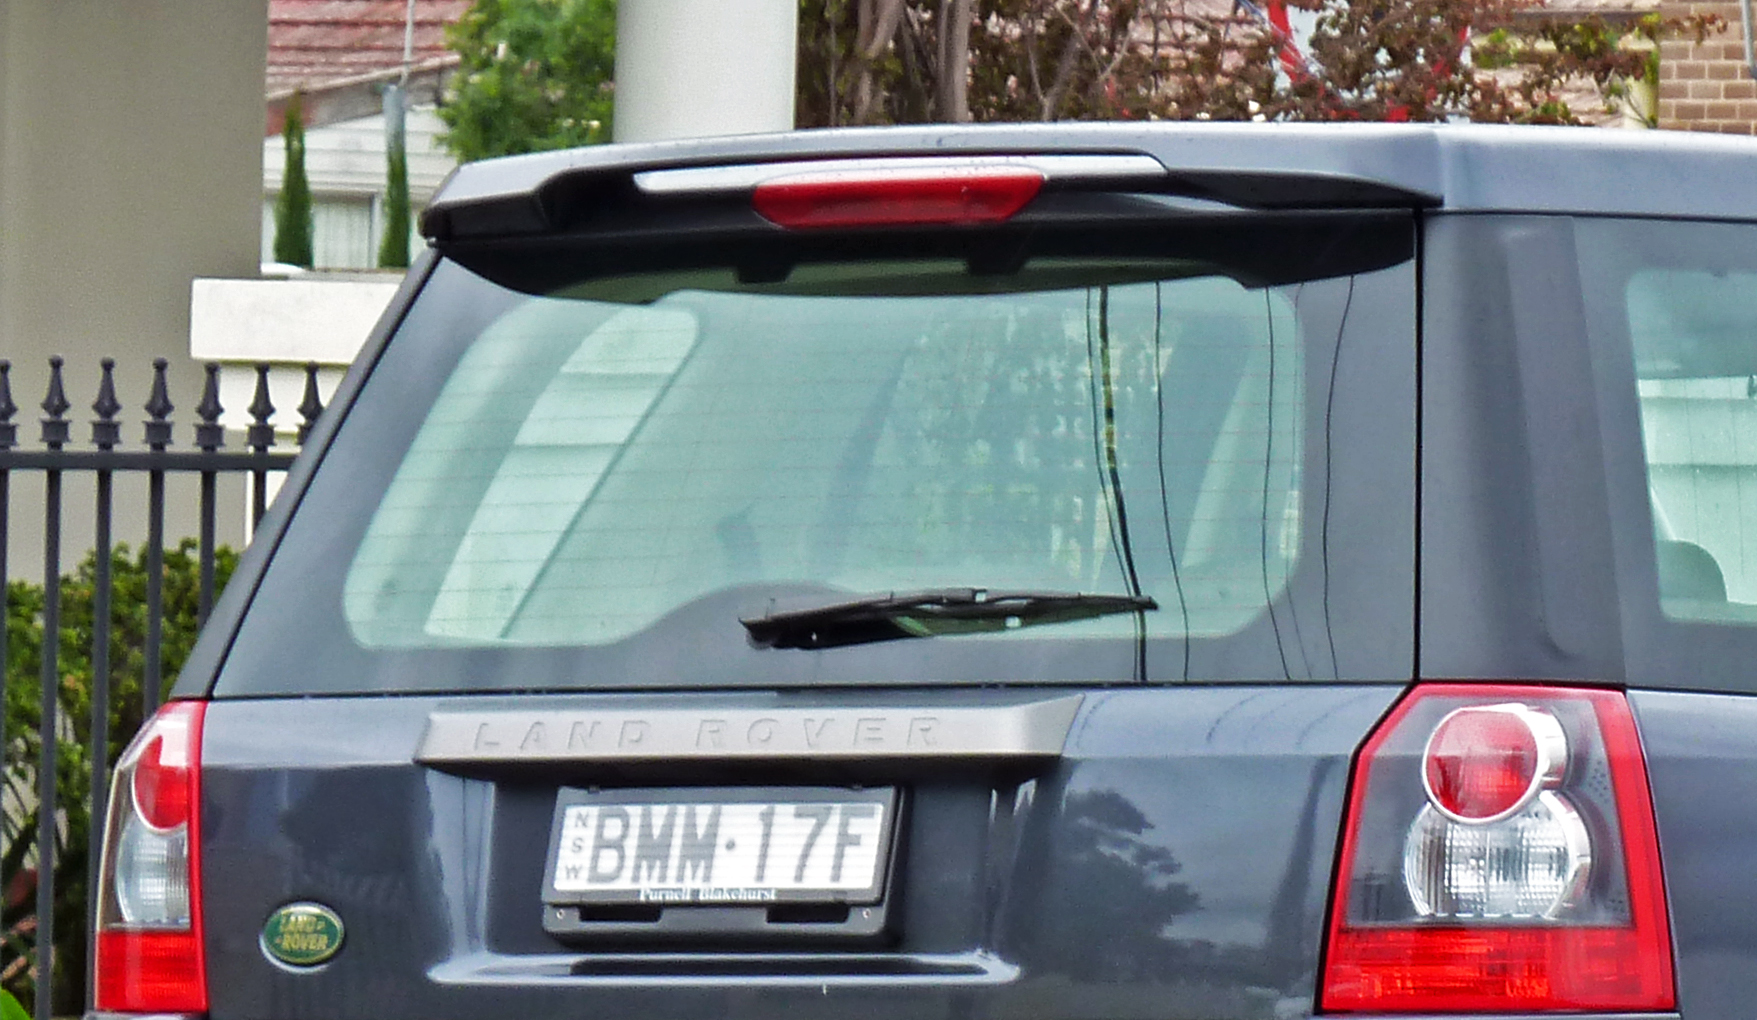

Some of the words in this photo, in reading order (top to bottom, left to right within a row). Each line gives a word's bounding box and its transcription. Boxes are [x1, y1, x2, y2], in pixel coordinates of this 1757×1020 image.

[473, 719, 650, 751] LAND
[695, 716, 941, 750] ROVER
[281, 932, 329, 951] ROVER
